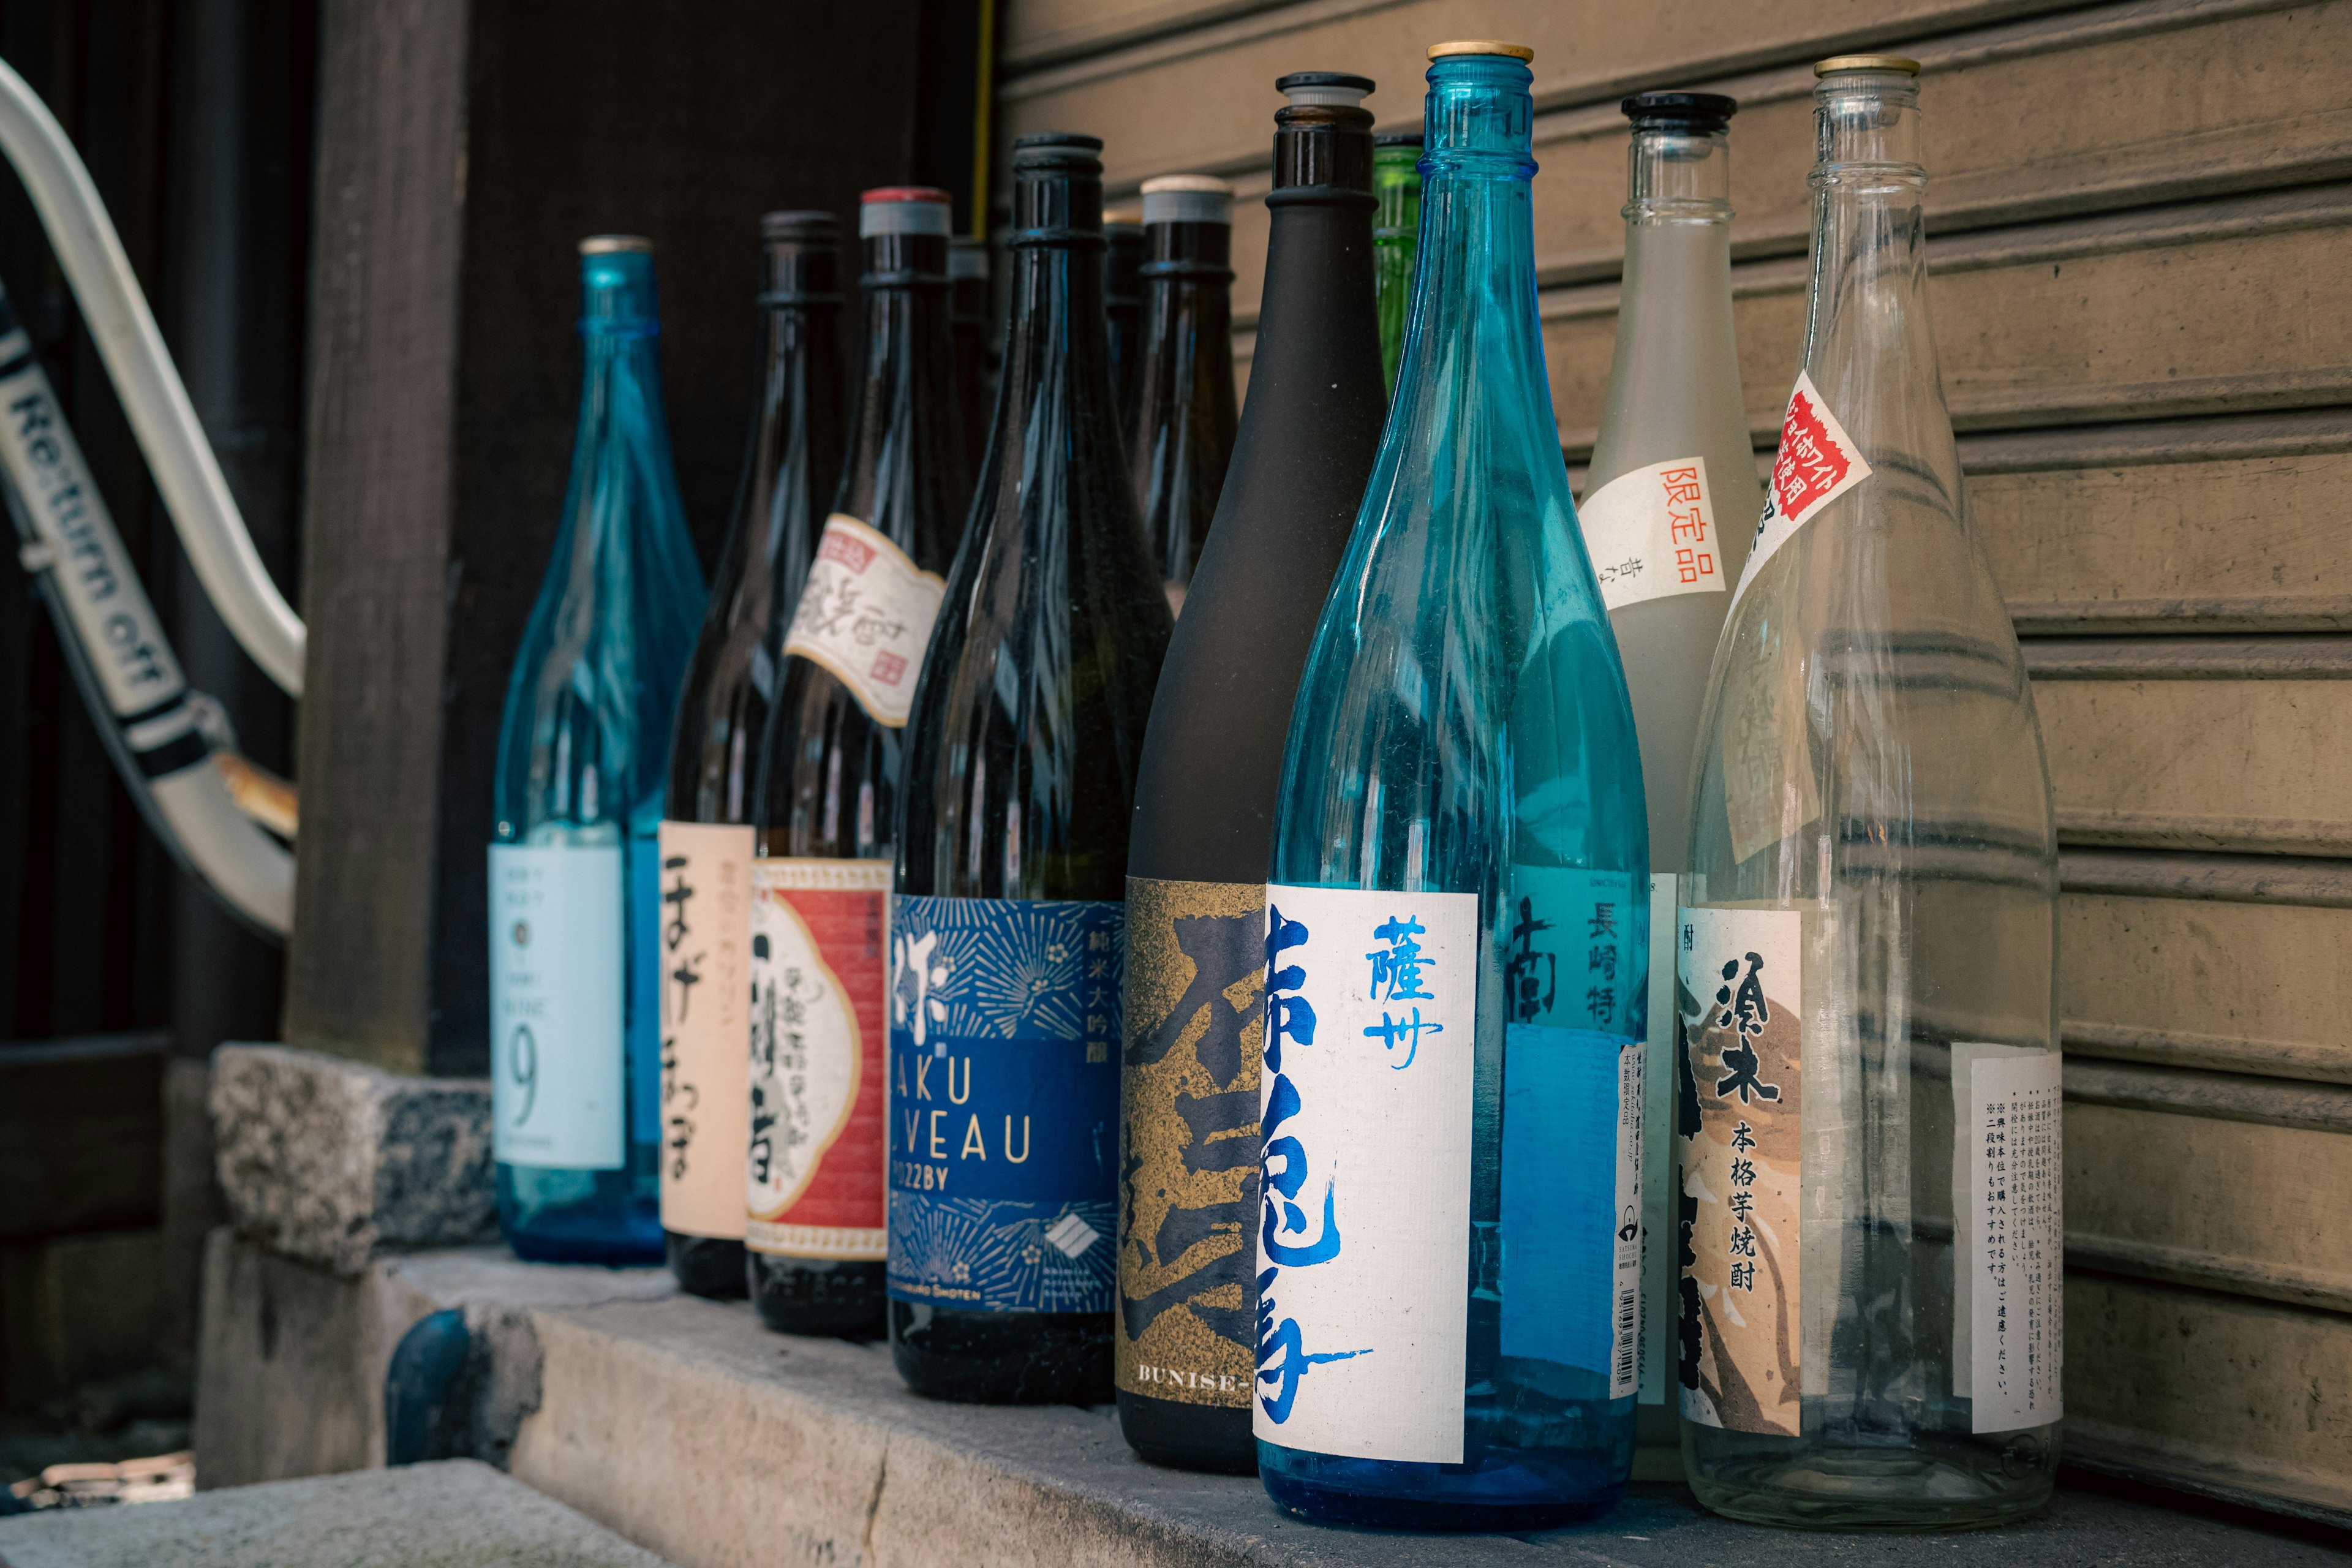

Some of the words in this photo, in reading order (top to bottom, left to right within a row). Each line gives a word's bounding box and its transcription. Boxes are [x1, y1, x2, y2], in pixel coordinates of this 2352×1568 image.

[1660, 467, 1714, 584] 限定品
[508, 1021, 538, 1128] 9
[1619, 1244, 1637, 1253] SATSUMA
[1729, 1122, 1757, 1291] 本格芋焼酎
[1986, 1103, 1997, 1280] ※二段割りもおすすめです。
[1997, 1103, 2007, 1395] ※興味本位で購入される方はご遠慮ください。
